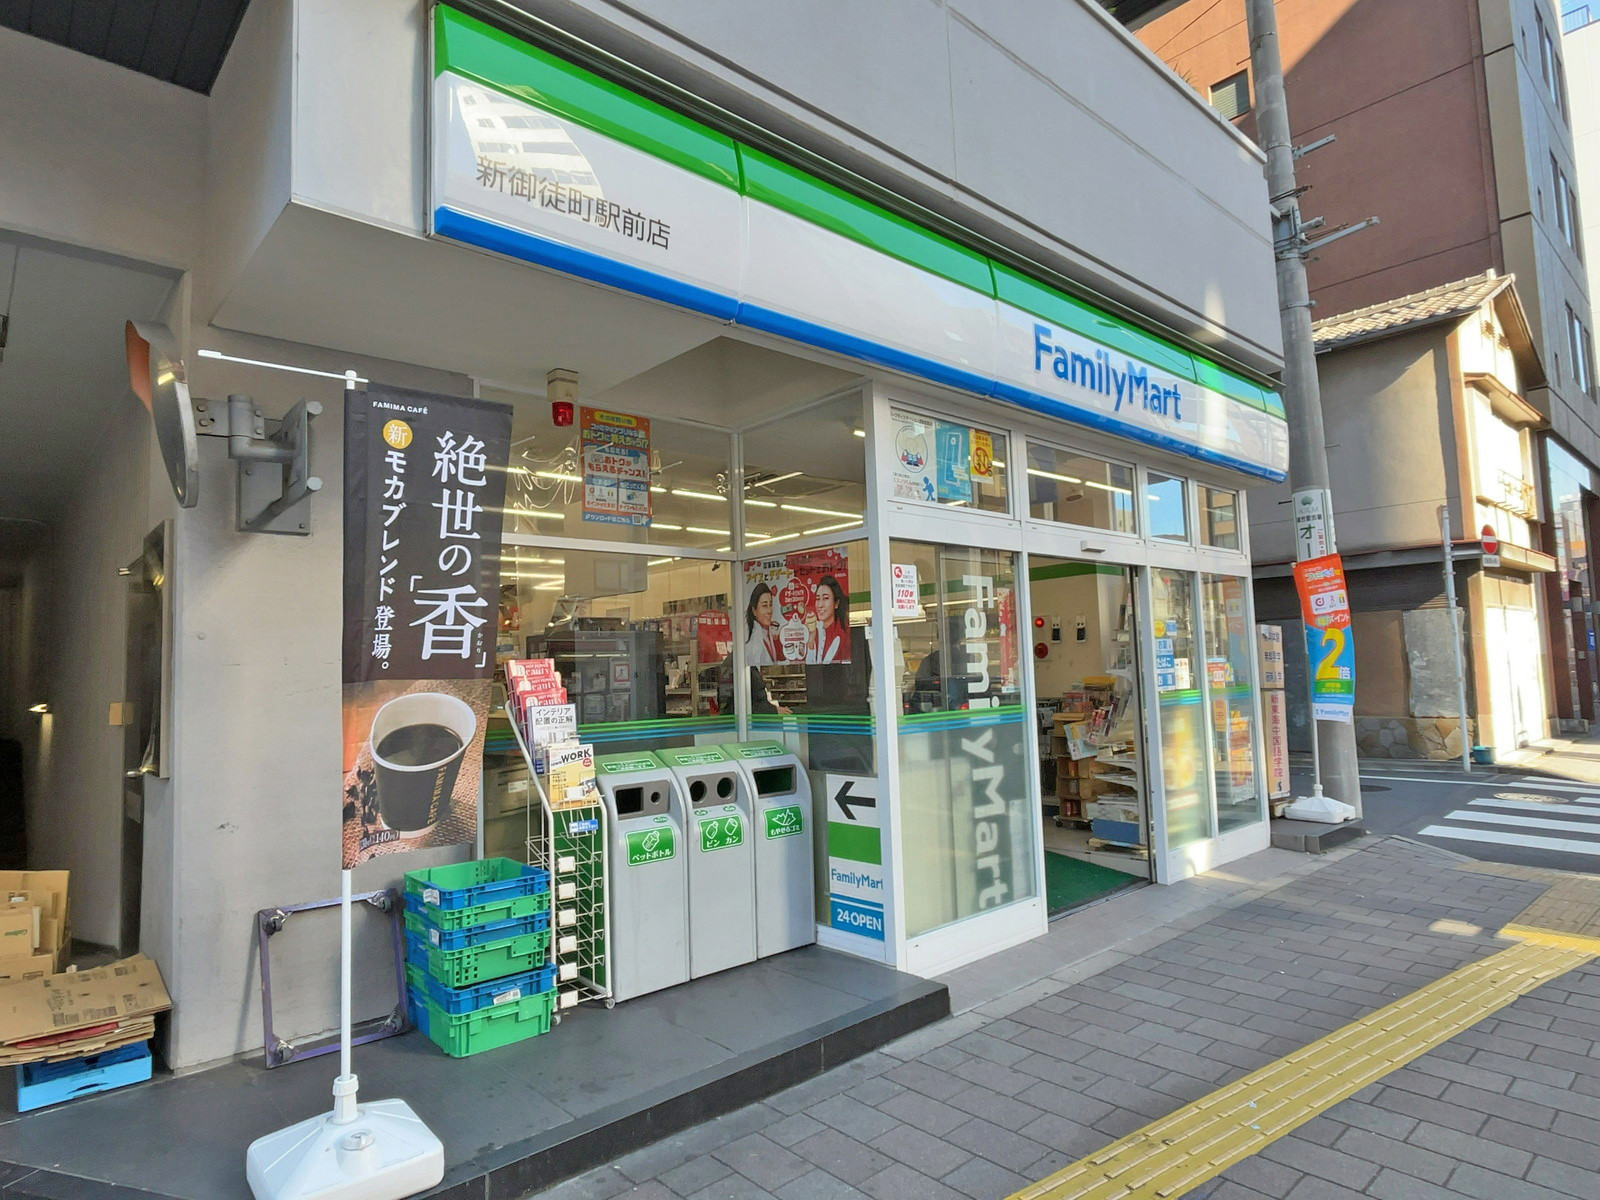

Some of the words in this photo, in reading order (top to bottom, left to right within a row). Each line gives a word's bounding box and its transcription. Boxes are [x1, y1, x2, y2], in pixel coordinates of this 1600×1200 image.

[476, 155, 671, 250] 新御徒町駅前店
[1033, 322, 1182, 421] FamilyMart
[372, 401, 406, 412] FAMIMA
[406, 406, 429, 415] CAFÉ
[387, 423, 408, 448] 新
[408, 429, 489, 669] 絶世の「香」
[371, 450, 407, 671] モカブレンド登場。
[535, 707, 572, 717] インテリア
[535, 715, 574, 726] 配置の正解
[560, 748, 593, 764] WORK
[770, 824, 801, 836] もやせるゴミ
[725, 836, 739, 844] カン
[631, 848, 672, 861] ペットボトル
